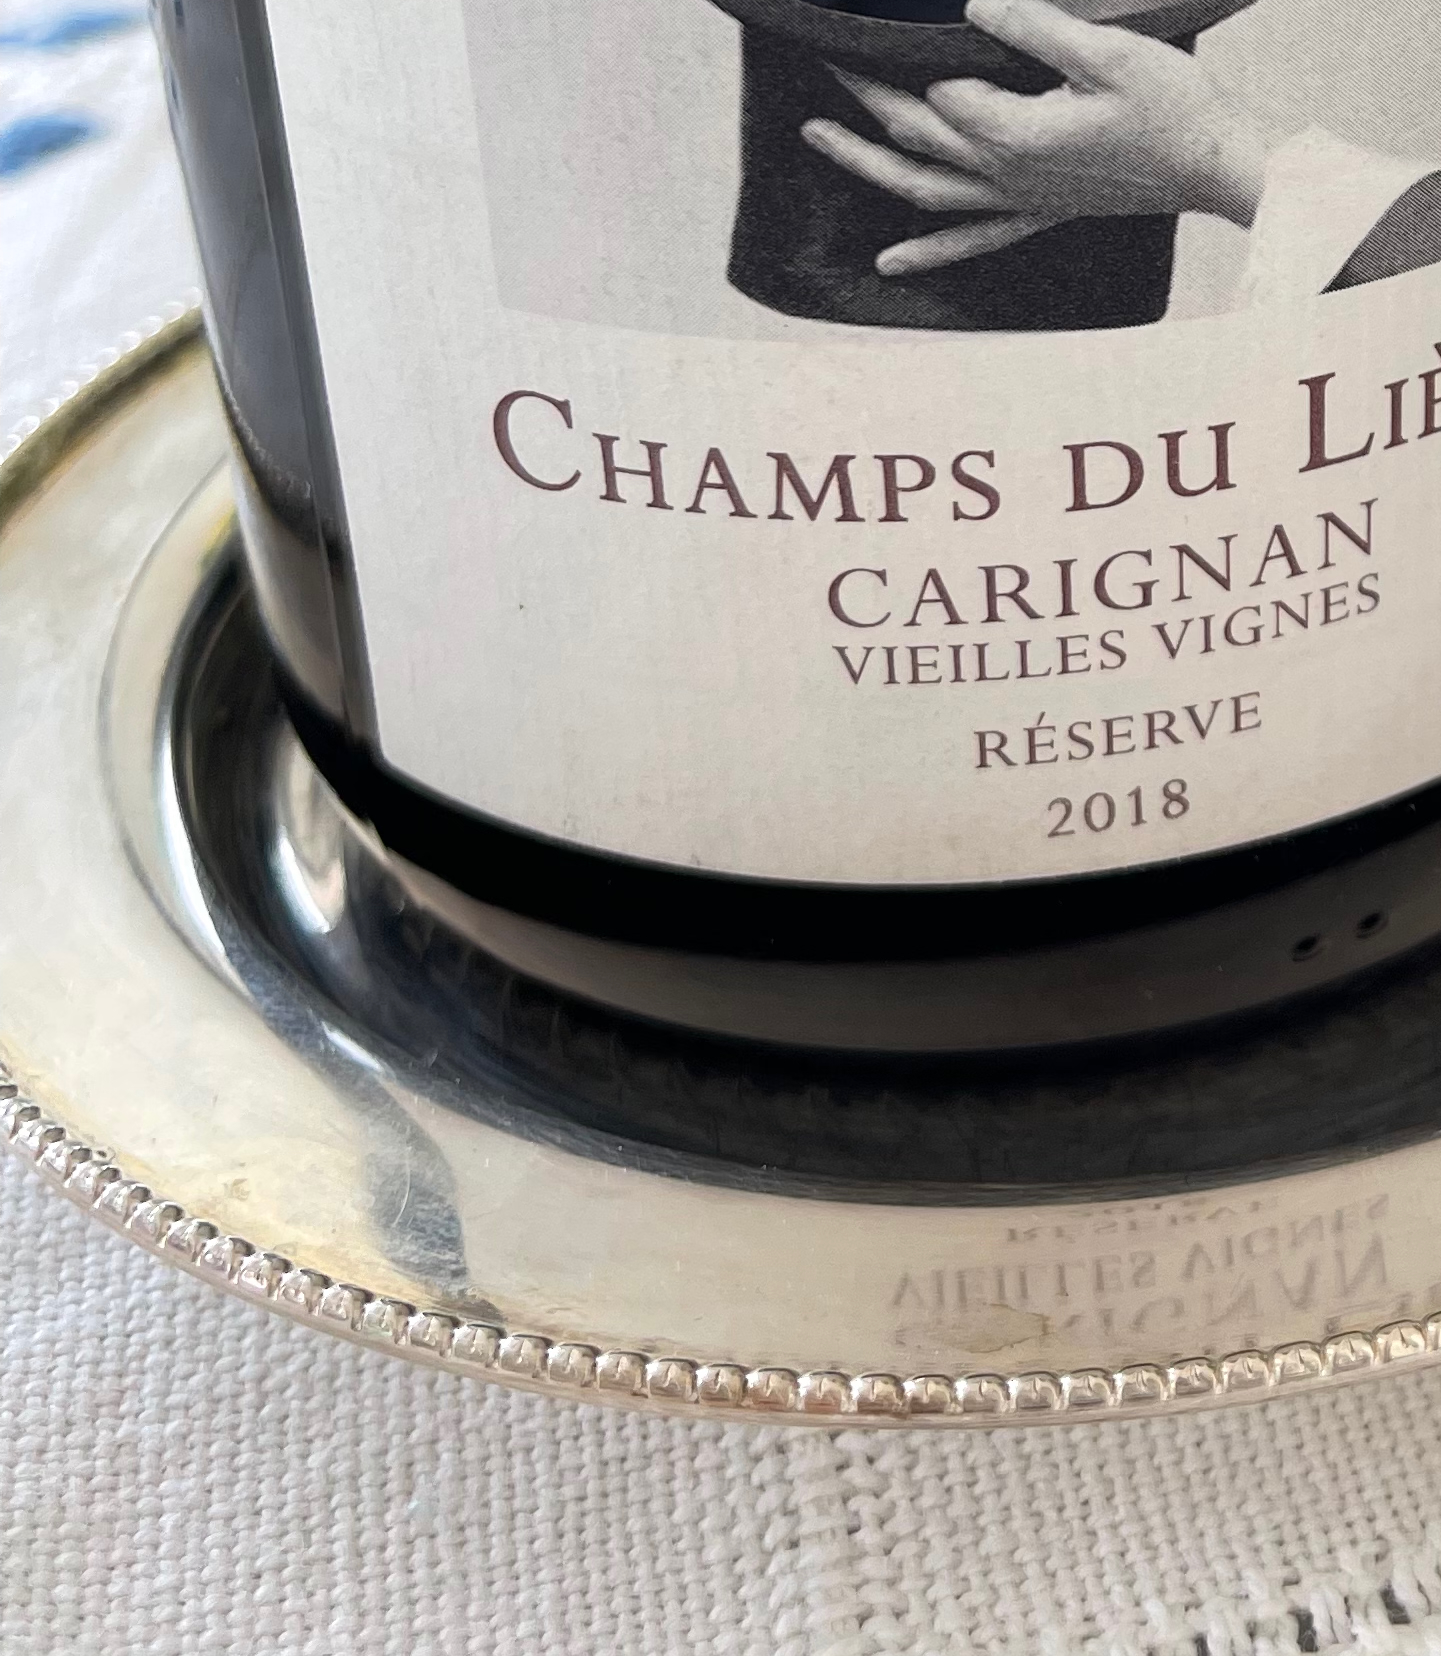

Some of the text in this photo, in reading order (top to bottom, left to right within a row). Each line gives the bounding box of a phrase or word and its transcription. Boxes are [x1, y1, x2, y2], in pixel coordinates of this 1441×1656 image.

[493, 390, 1000, 523] CHAMPS
[1062, 421, 1237, 512] DU
[828, 498, 1378, 628] CARIGNAN
[832, 572, 1380, 685] VIEILLES VIGNES
[974, 692, 1261, 769] RÉSERVE
[1048, 779, 1189, 838] 2018
